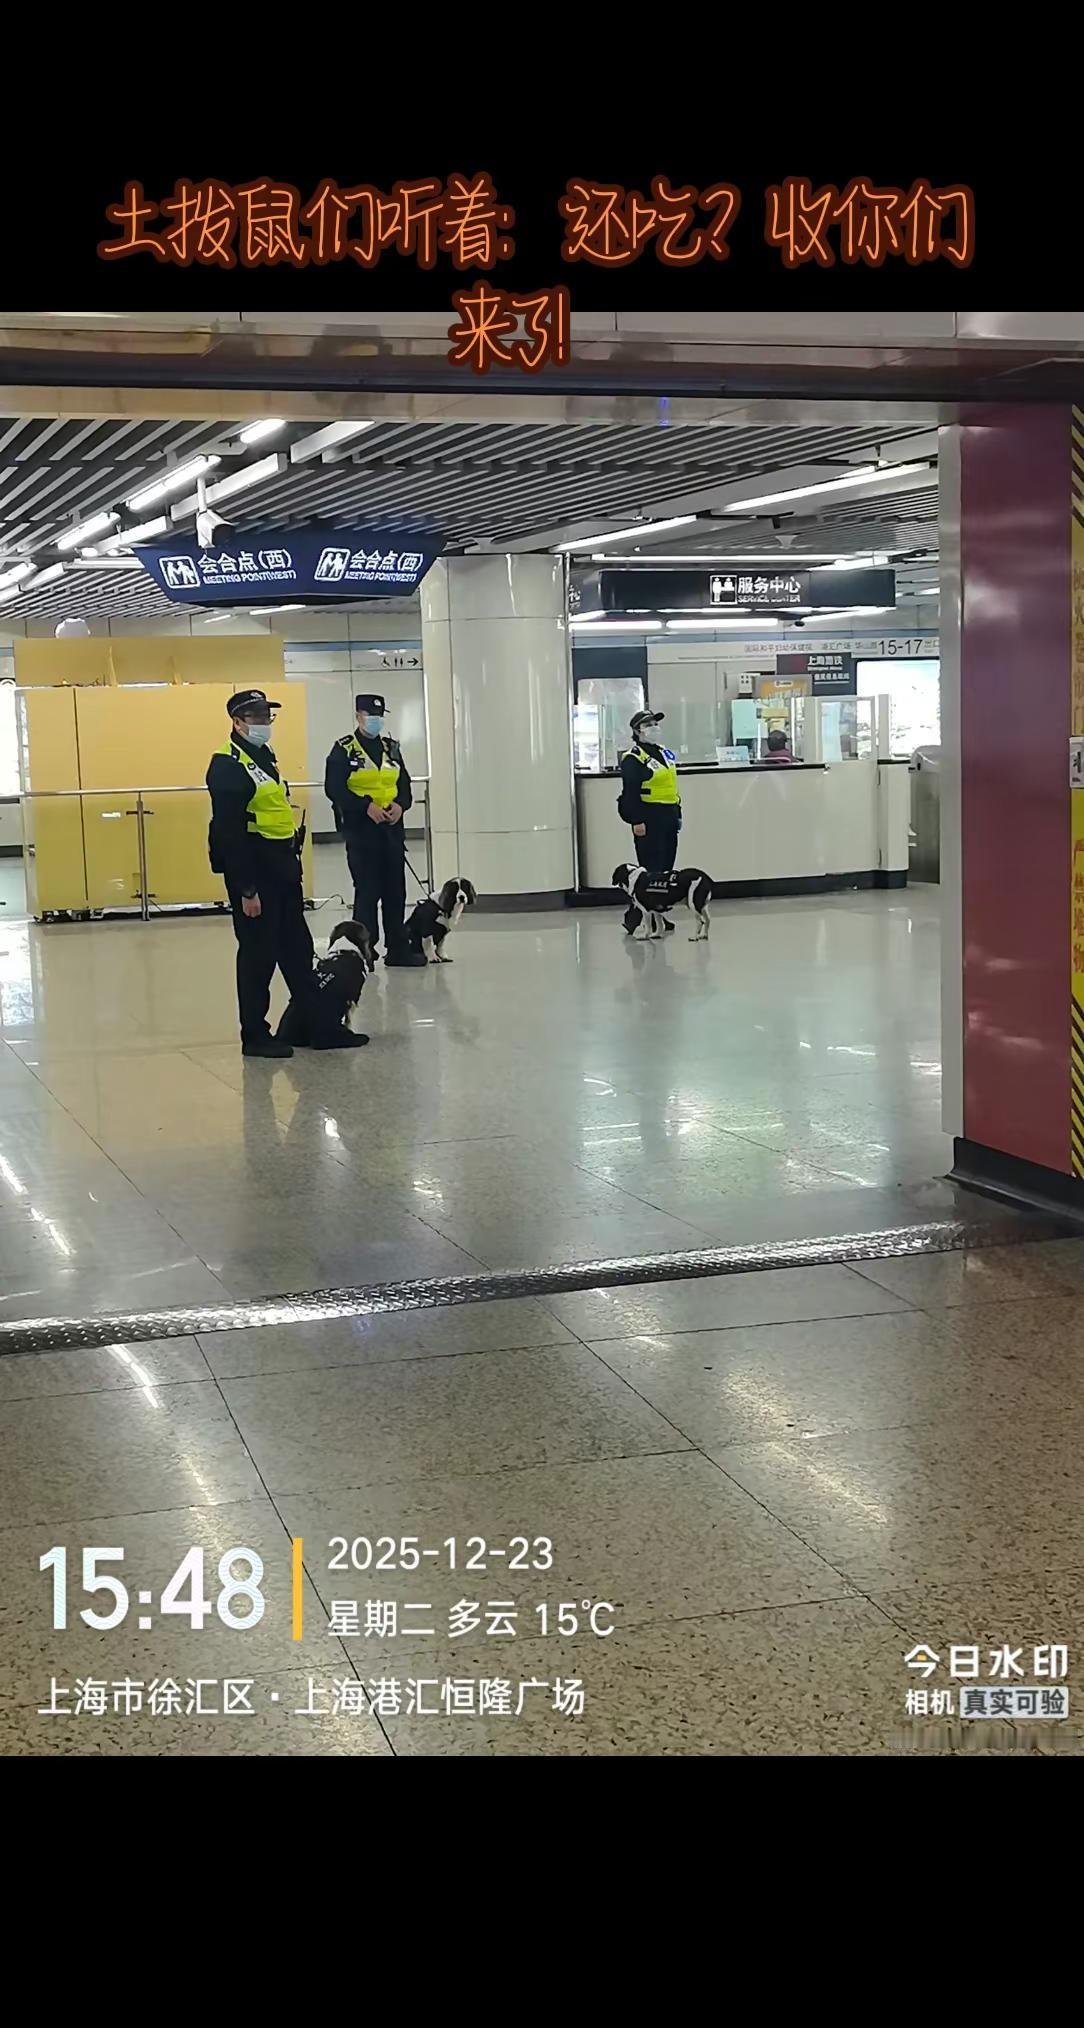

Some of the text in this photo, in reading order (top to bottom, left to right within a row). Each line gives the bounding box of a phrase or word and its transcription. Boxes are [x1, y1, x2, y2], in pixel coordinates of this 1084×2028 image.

[737, 575, 801, 594] 服务中心
[878, 639, 924, 655] 15-17
